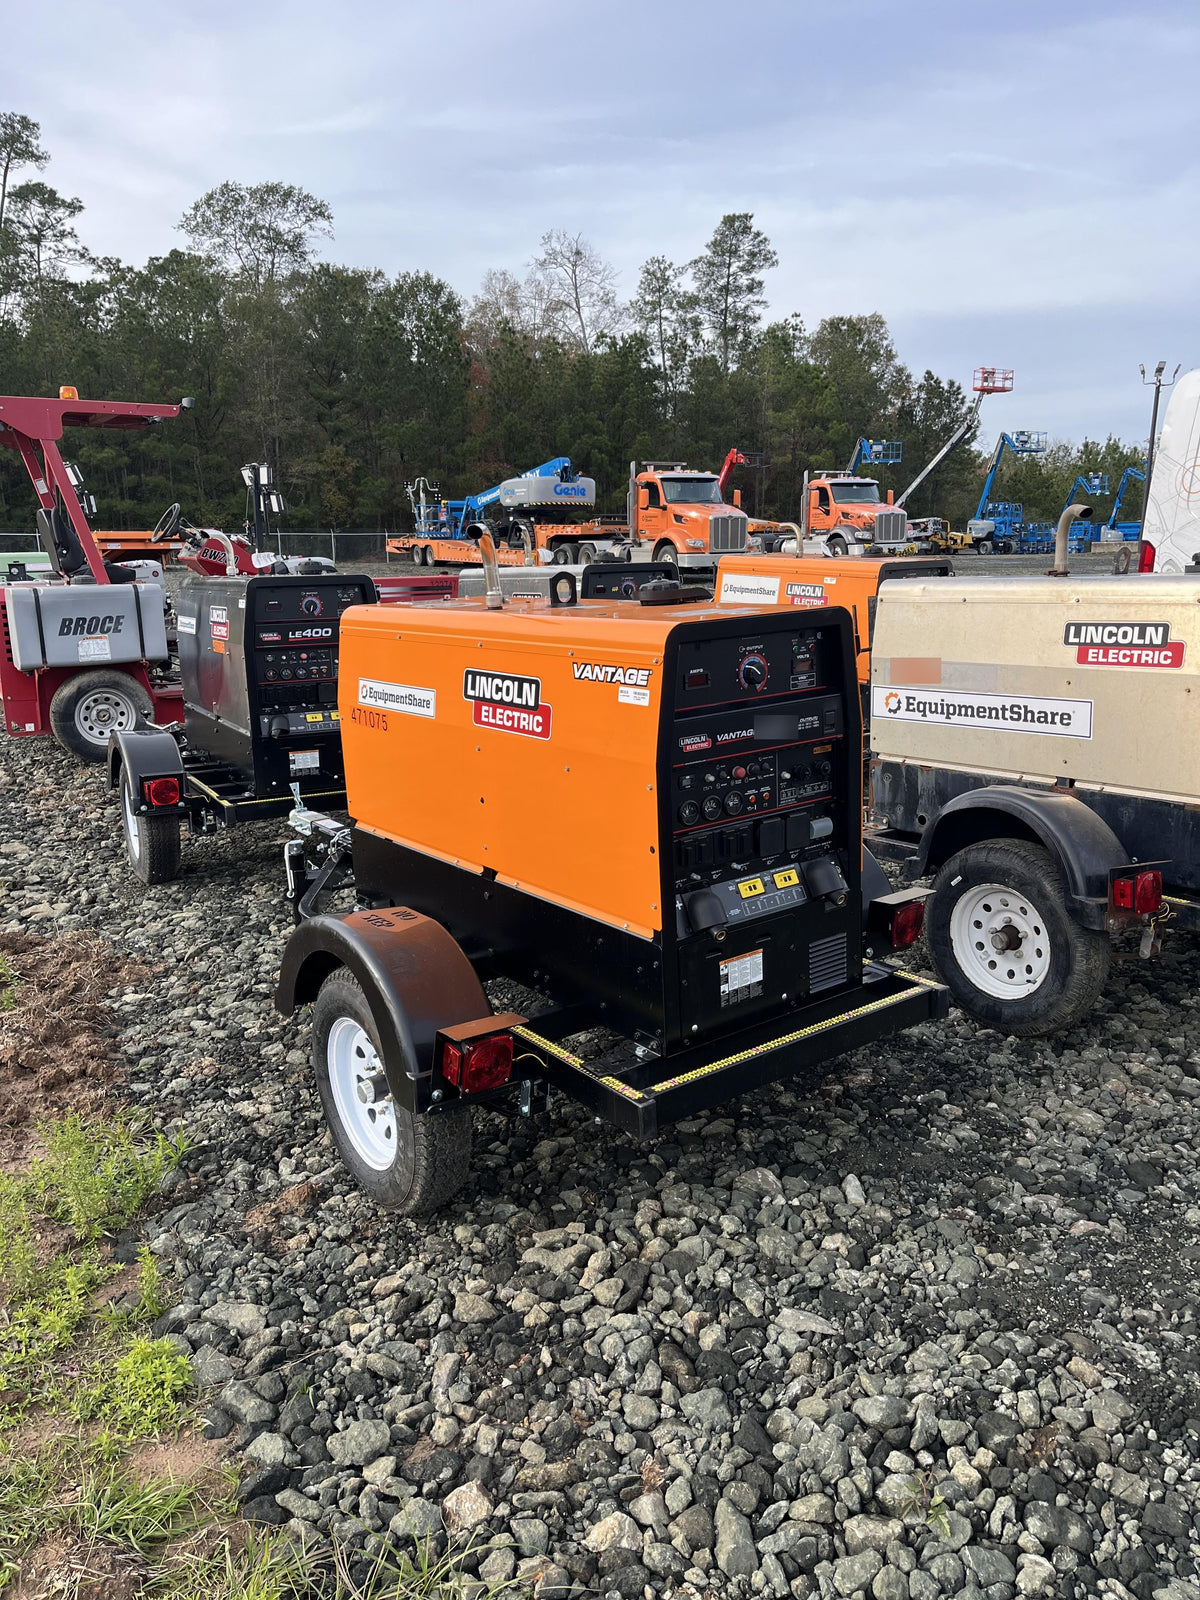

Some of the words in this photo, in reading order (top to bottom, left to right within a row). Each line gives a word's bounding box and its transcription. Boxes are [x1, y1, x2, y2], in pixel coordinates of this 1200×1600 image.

[553, 483, 586, 497] Genie
[201, 547, 239, 565] BW20
[729, 584, 776, 597] EquipmentShare
[787, 583, 822, 597] LINCOLN
[58, 615, 125, 637] BROCE
[288, 628, 332, 638] LE400
[1068, 625, 1164, 646] LINCOLN
[1087, 648, 1172, 665] ELECTRIC
[573, 662, 651, 687] VANTAGE
[368, 686, 431, 710] EquipmentShare
[467, 674, 537, 707] LINCOLN
[351, 708, 388, 731] 471075
[481, 705, 543, 733] ELECTRIC
[905, 695, 1072, 728] EquipmentShare
[680, 735, 707, 746] LINCOLN
[716, 728, 755, 742] VANTAG
[686, 741, 709, 751] ELECTRIC
[361, 914, 395, 927] STEP
